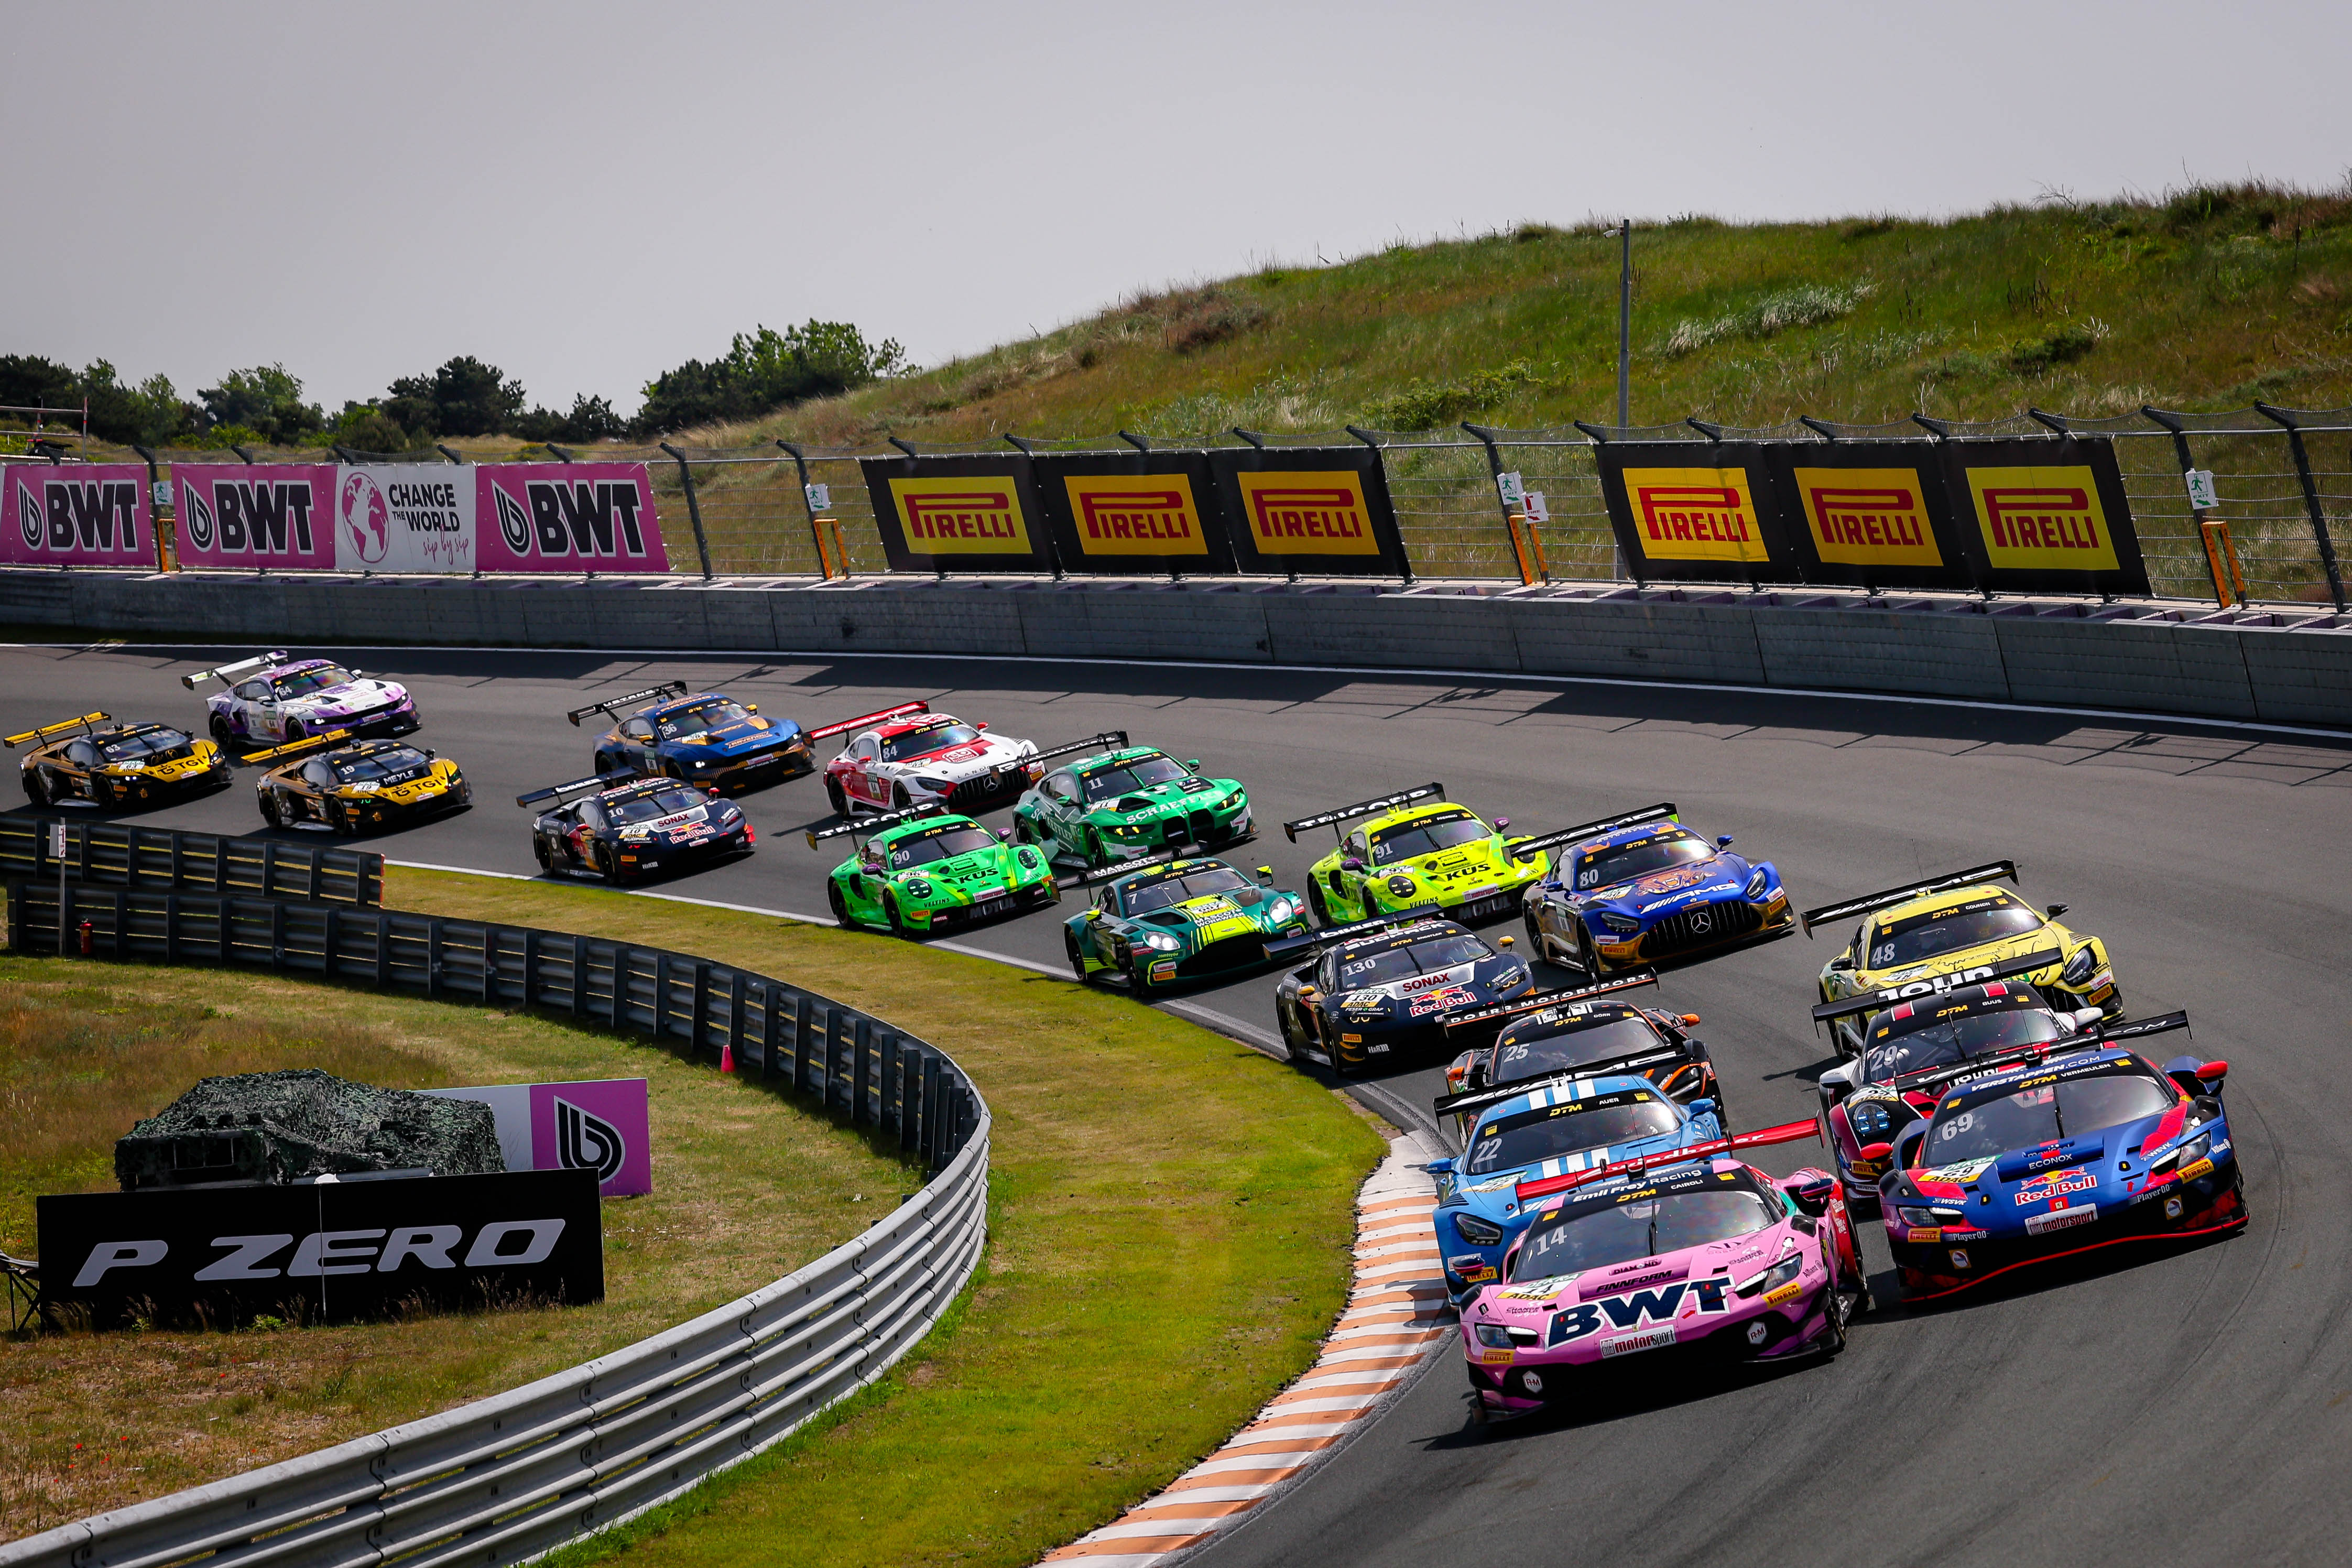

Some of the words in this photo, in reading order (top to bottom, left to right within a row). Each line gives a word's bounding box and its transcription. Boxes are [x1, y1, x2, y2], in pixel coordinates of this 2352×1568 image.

[388, 484, 456, 508] CHANGE
[44, 480, 139, 552] BWT
[212, 480, 314, 555] BWT
[393, 510, 406, 521] THE
[406, 511, 461, 532] WORLD
[525, 480, 646, 558] BWT
[903, 493, 1016, 538] PIRELLI
[1079, 491, 1191, 538] PIRELLI
[1251, 488, 1363, 538] PIRELLI
[1637, 487, 1749, 542] PIRELLI
[1810, 488, 1924, 546] PIRELLI
[1982, 488, 2099, 548] PIRELLI
[423, 535, 437, 559] sip
[440, 524, 453, 566] by
[455, 533, 469, 559] sip
[279, 685, 292, 698] 64
[593, 689, 655, 712] USTANG
[662, 724, 677, 735] 36
[106, 744, 121, 754] 63
[883, 745, 898, 759] 84
[175, 758, 205, 769] TGI
[341, 765, 355, 775] 19
[383, 770, 415, 785] MEYLE
[410, 780, 442, 791] TGI
[1088, 777, 1104, 790] 11
[608, 808, 624, 818] 10
[1126, 790, 1225, 824] SCHAEFFLER
[658, 813, 690, 827] SONAX
[670, 833, 693, 844] Red
[693, 826, 715, 837] Bull
[894, 850, 910, 864] 90
[1375, 842, 1393, 859] 91
[959, 868, 999, 885] KÜS
[1580, 869, 1598, 887] 80
[1129, 893, 1137, 905] 7
[1673, 883, 1739, 902] AMG
[924, 898, 950, 908] VELTINS
[1409, 896, 1439, 909] VELTINS
[1965, 901, 1991, 910] GOUNON
[1196, 912, 1246, 928] WORKWEAR
[1932, 908, 1959, 920] DTM
[1390, 938, 1413, 948] DTM
[1871, 943, 1896, 965] 48
[1345, 959, 1376, 976] 130
[1402, 973, 1451, 992] SONAX
[1410, 1003, 1443, 1017] Red
[1443, 993, 1477, 1006] Bull
[1451, 1005, 1512, 1023] DOERR
[1521, 973, 1647, 1007] MOTORSPORT
[1936, 1005, 1968, 1017] DTM
[1554, 1016, 1582, 1027] DTM
[1504, 1043, 1531, 1063] 25
[1870, 1045, 1898, 1072] 29
[1971, 1055, 2100, 1092] VERSTAPPEN.COM
[2061, 1063, 2111, 1077] VERMEULEN
[2019, 1074, 2057, 1088] DTM
[1549, 1103, 1583, 1117] DTM
[1599, 1097, 1619, 1106] AUER
[1942, 1113, 1974, 1141] 69
[1473, 1138, 1502, 1163] 22
[2149, 1141, 2174, 1158] WSVK
[2211, 1143, 2226, 1155] Allianz
[1943, 1156, 1997, 1171] DEKRA
[2029, 1153, 2073, 1170] ECONOX
[1943, 1167, 1975, 1177] 69
[2183, 1161, 2211, 1180] PIRELLI
[1573, 1185, 1608, 1203] Emil
[1610, 1181, 1647, 1195] Frey
[1649, 1169, 1702, 1185] Racing
[1671, 1179, 1703, 1190] CAIROLI
[2016, 1186, 2054, 1205] Red
[2058, 1175, 2097, 1194] Bull
[1616, 1189, 1656, 1203] DTM
[2137, 1188, 2161, 1203] Player
[2043, 1210, 2096, 1232] motorsport
[1537, 1226, 1567, 1256] 14
[1910, 1231, 1936, 1241] PIRELLI
[1953, 1232, 1976, 1241] Player
[72, 1240, 169, 1287] P
[194, 1218, 566, 1281] ZERO
[1803, 1265, 1818, 1278] Allianz
[1522, 1284, 1552, 1294] 14
[1596, 1270, 1672, 1293] FINNFORM
[1767, 1284, 1800, 1304] PIRELLI
[1545, 1274, 1736, 1352] BWT
[1615, 1330, 1674, 1353] motorsport
[1484, 1352, 1510, 1362] PIRELLI
